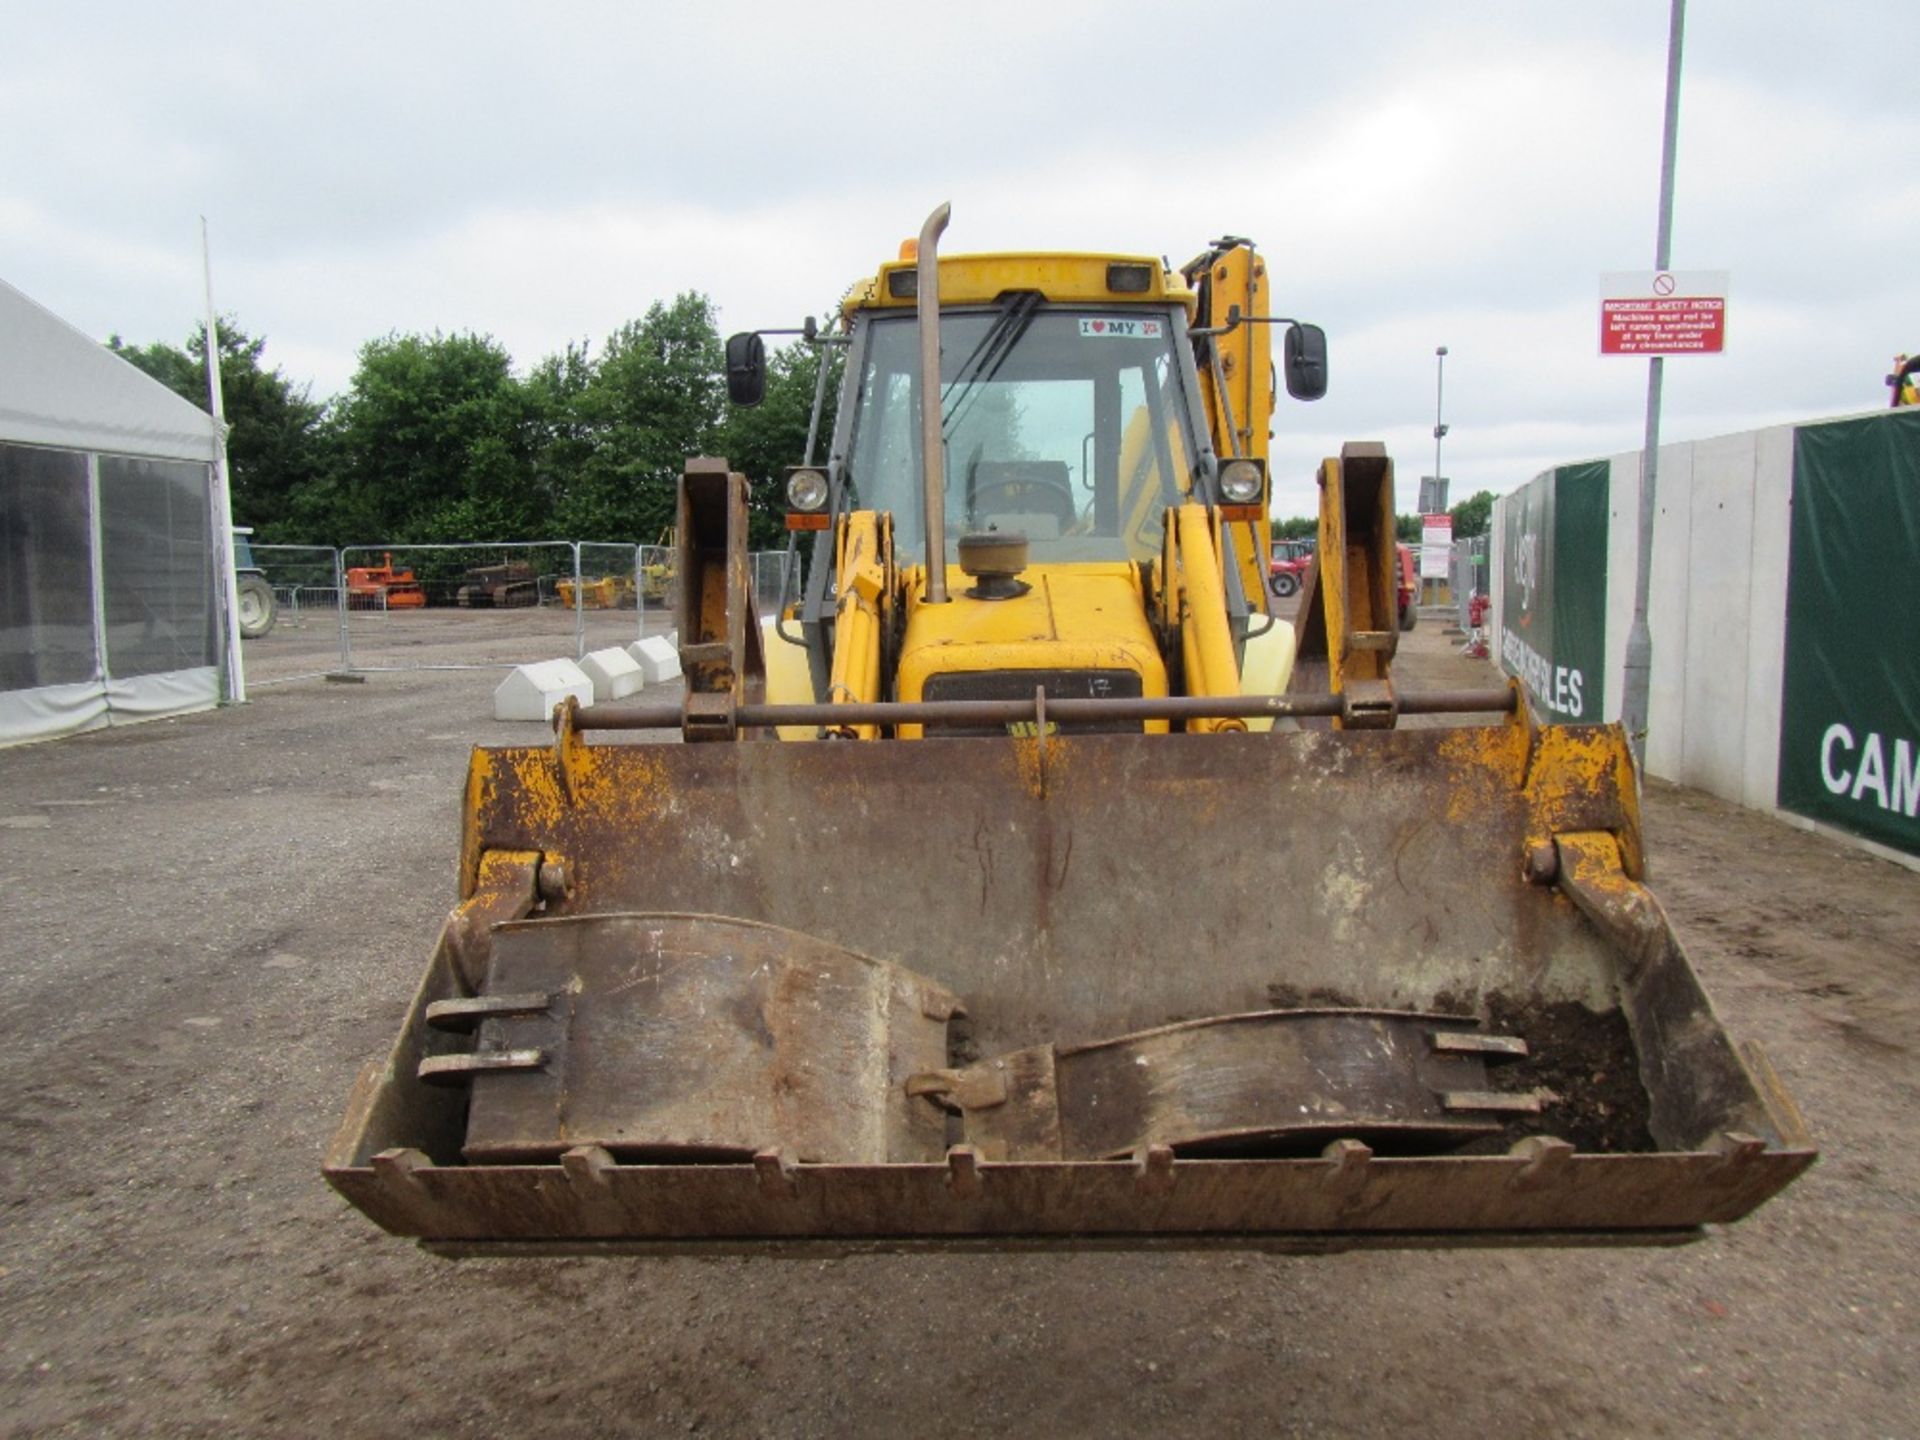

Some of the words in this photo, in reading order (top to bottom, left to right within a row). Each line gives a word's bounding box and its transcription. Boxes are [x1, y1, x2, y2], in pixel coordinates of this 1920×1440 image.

[1655, 301, 1689, 310] SAFETY
[1691, 301, 1722, 310] NOTICE
[1612, 313, 1655, 322] Machines
[1658, 313, 1681, 322] must
[1683, 312, 1698, 321] not
[1701, 312, 1713, 320] be
[1107, 321, 1135, 334] MY
